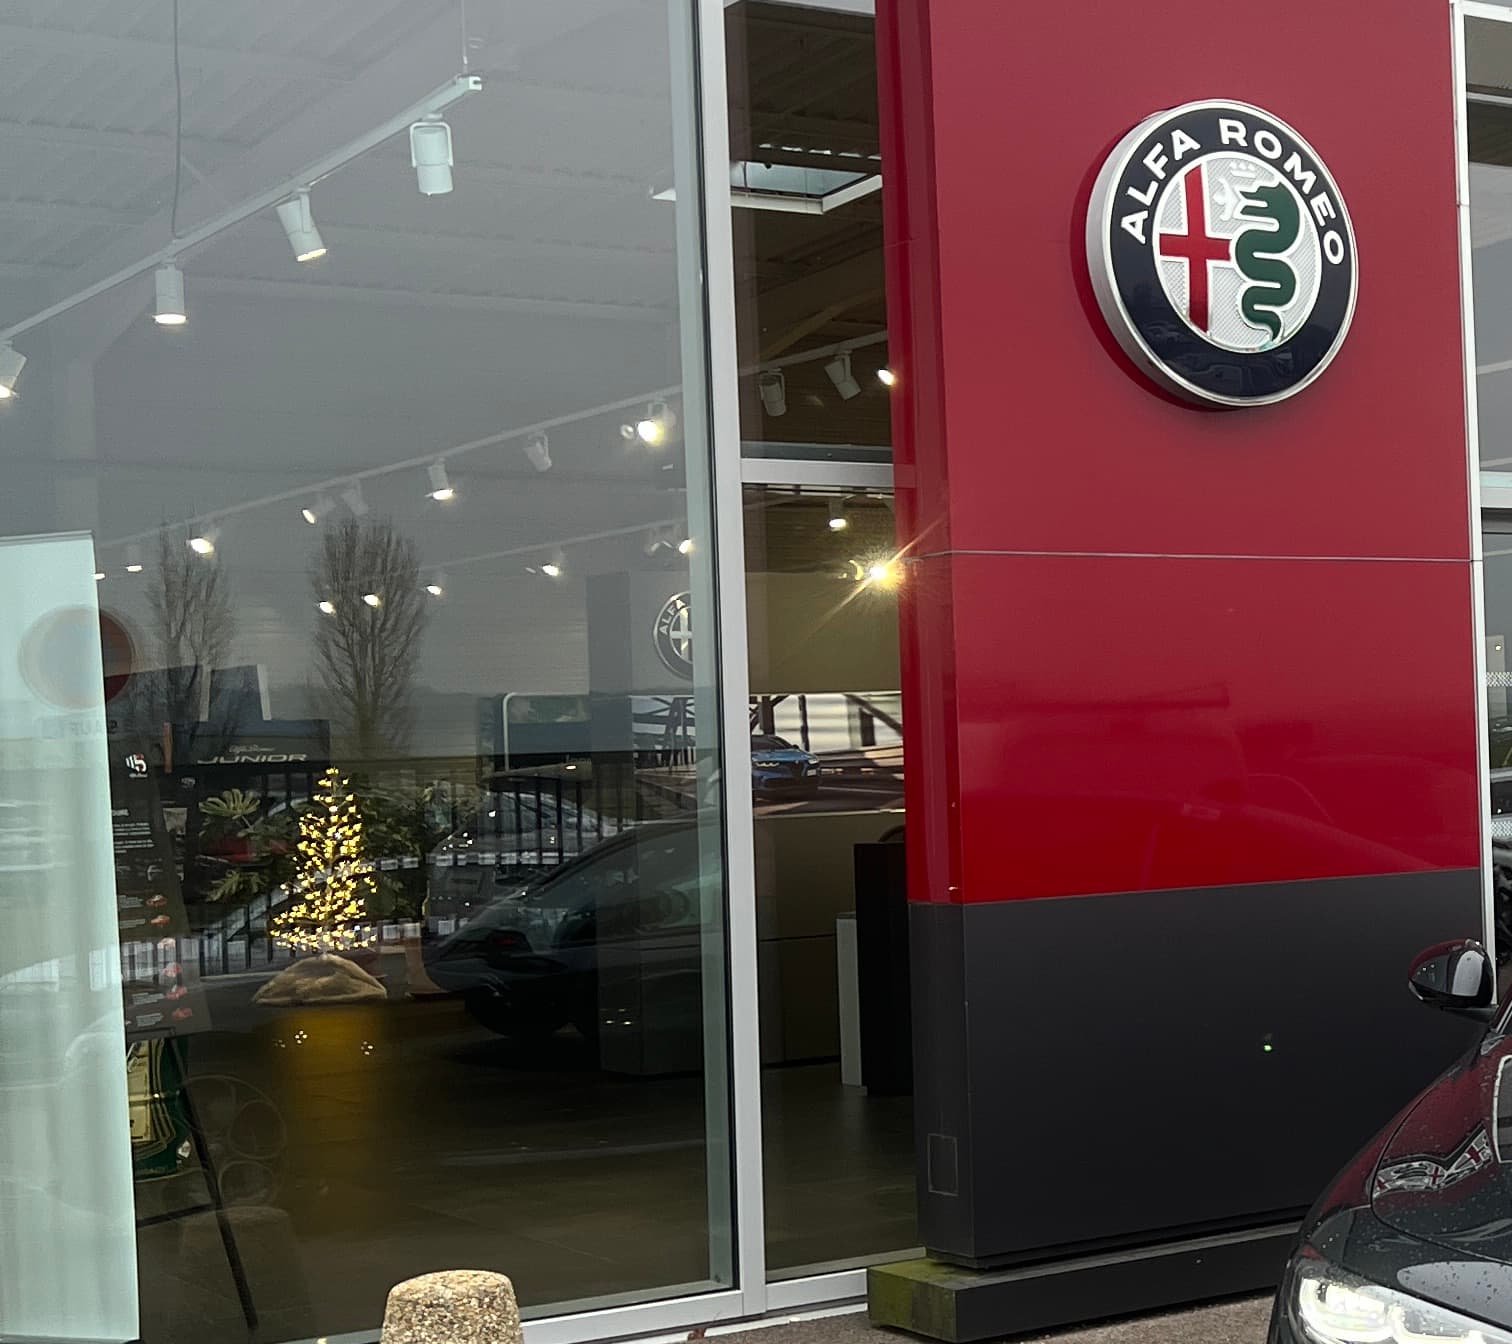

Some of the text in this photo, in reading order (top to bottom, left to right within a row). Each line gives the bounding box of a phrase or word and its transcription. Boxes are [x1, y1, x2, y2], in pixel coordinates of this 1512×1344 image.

[1120, 117, 1345, 266] ALFA ROMEO
[659, 599, 687, 636] ALFA
[197, 754, 307, 765] JUNIOR
